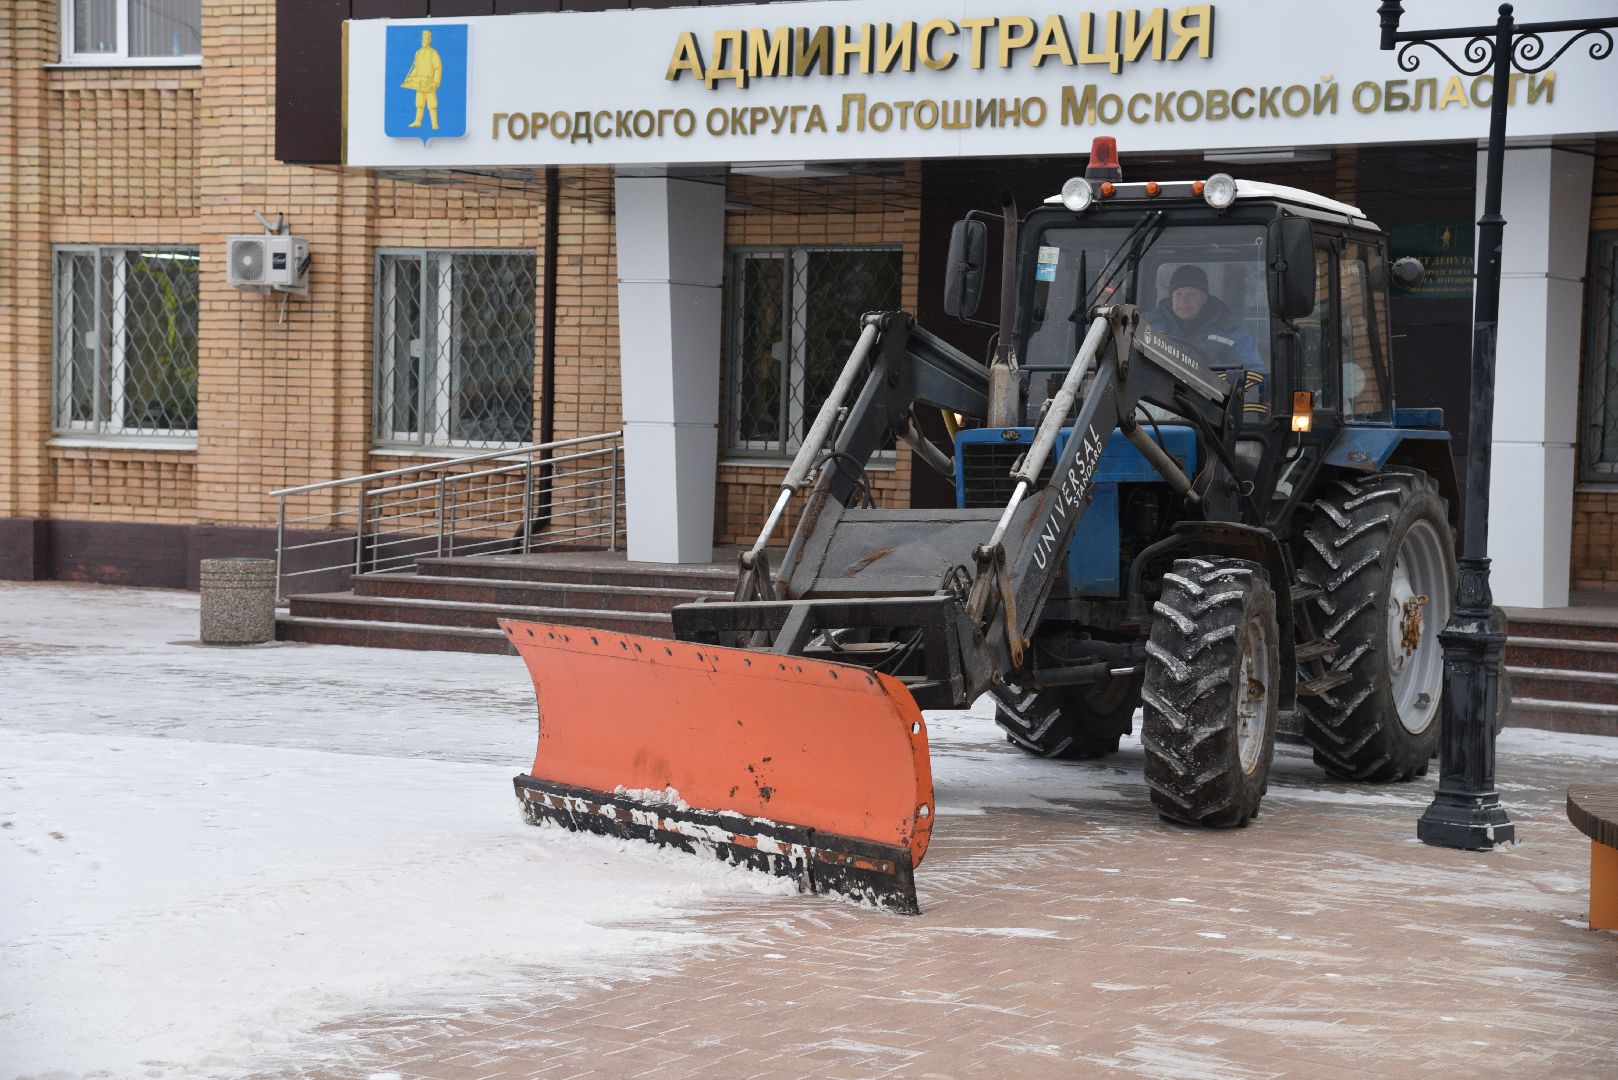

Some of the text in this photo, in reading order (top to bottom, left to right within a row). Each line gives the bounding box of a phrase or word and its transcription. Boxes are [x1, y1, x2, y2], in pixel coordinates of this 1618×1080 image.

[665, 5, 1213, 90] АДМИНИСТРАЦИЯ
[492, 107, 696, 143] ГОРОДСКОГО
[706, 103, 827, 135] ОКРУГА
[1352, 70, 1557, 114] ОБЛАСТИ
[1153, 335, 1180, 359] БОЛЬШАЯ
[1034, 424, 1100, 570] UNIVERSAL
[1073, 441, 1103, 508] STANDARD
